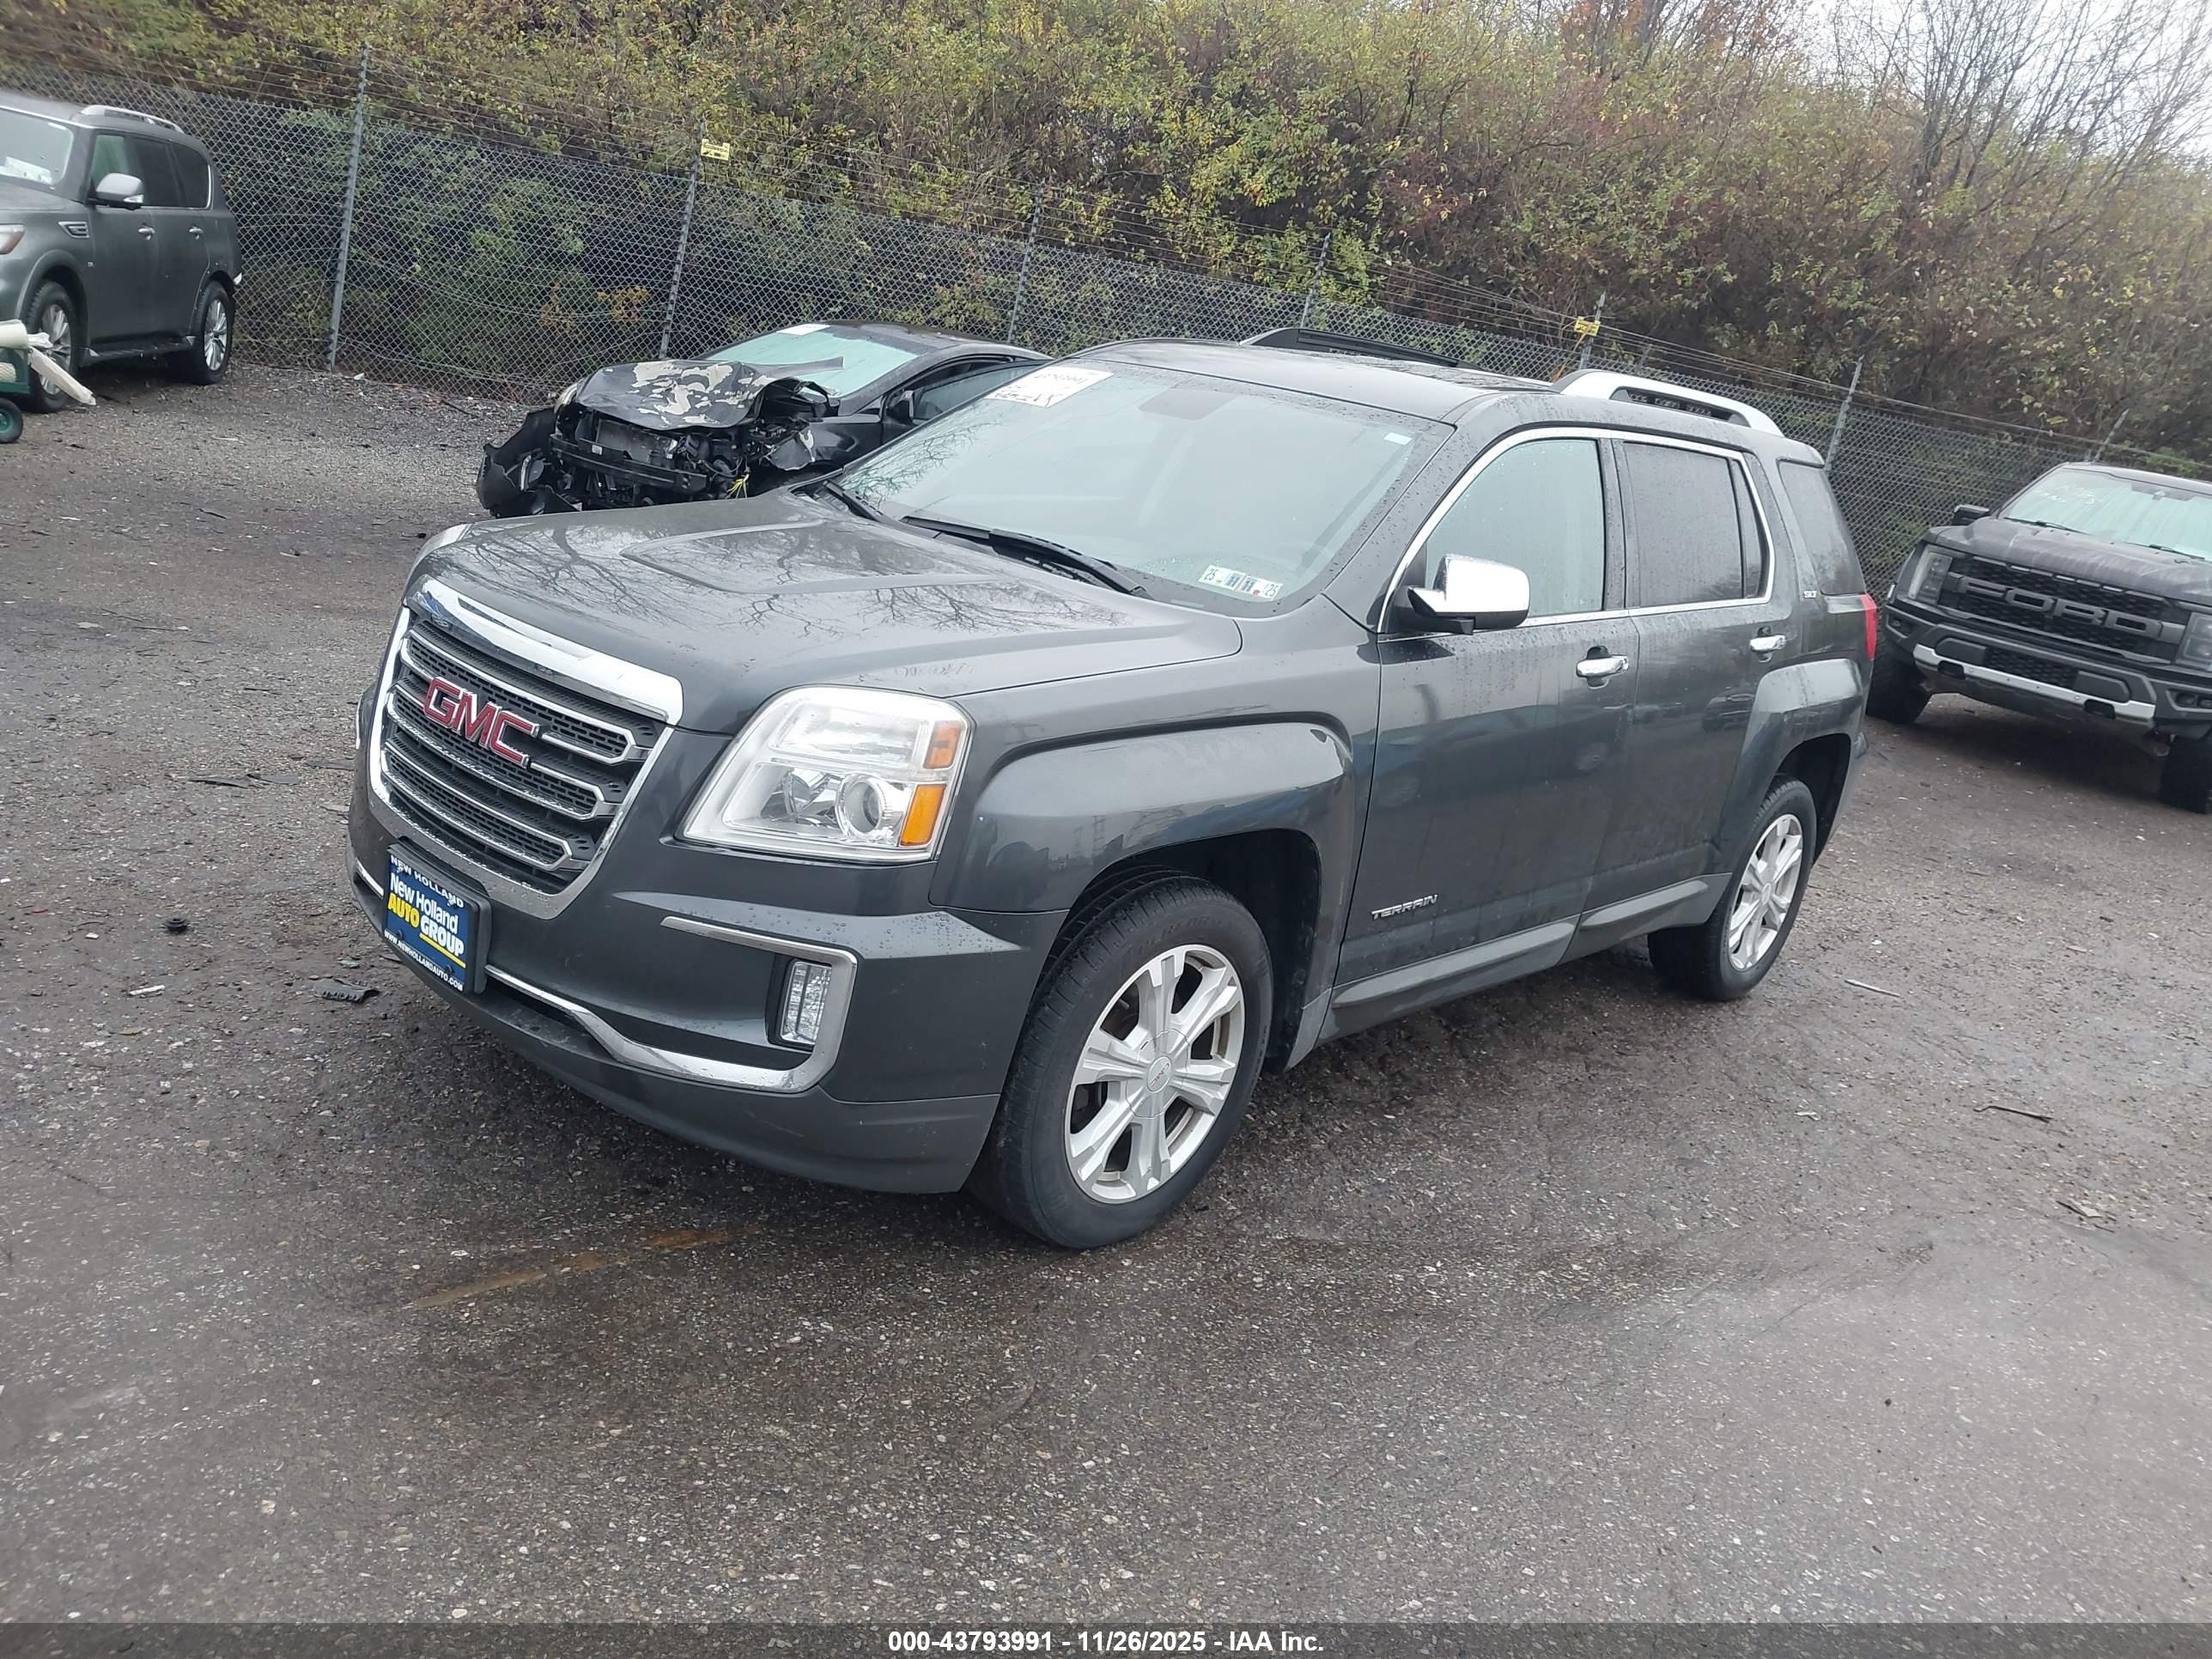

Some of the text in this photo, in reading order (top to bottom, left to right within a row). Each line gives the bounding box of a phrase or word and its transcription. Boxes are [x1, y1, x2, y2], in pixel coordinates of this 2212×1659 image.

[1963, 575, 2163, 640] FORD
[423, 677, 539, 769] GMC
[390, 854, 465, 908] NEW HOLLAND
[390, 872, 459, 934] New Holland
[1371, 894, 1438, 921] TERRAIN
[387, 892, 465, 957] AUTO GROUP
